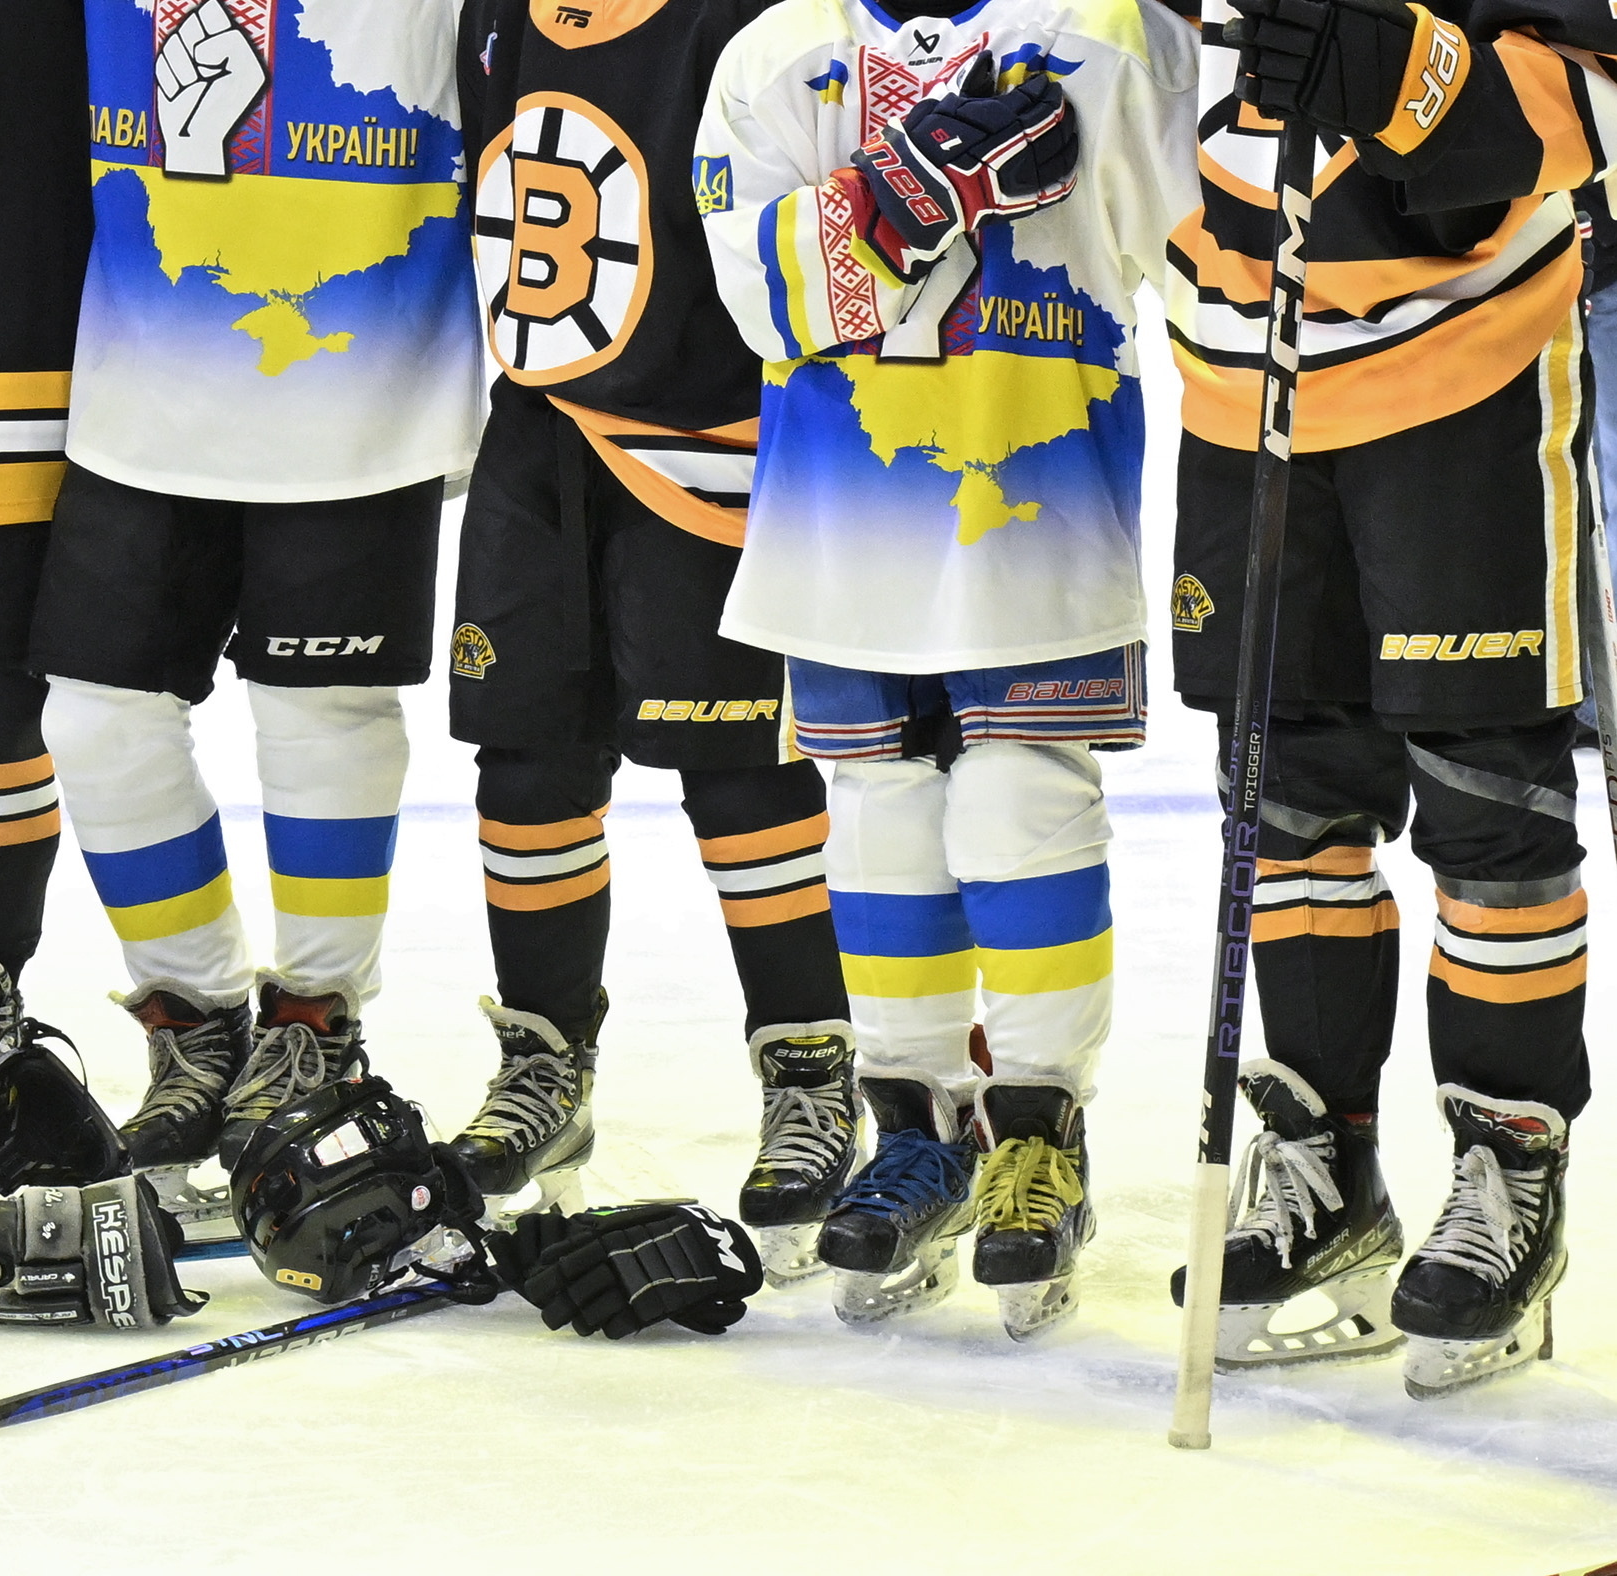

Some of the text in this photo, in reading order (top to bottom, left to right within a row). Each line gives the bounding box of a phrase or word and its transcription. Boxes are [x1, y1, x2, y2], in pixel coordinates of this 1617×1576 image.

[555, 5, 593, 30] TPS
[908, 55, 943, 66] BAUER
[288, 116, 418, 167] УКРАЇНІ!
[507, 157, 596, 320] B
[1264, 180, 1315, 462] CCM
[267, 635, 385, 657] CCM
[1380, 629, 1544, 661] BAUER
[1006, 678, 1124, 702] BAUER
[637, 699, 778, 722] BAUER
[1250, 721, 1262, 731] 7
[1244, 732, 1262, 812] TRIGGER
[1218, 820, 1258, 1060] RIBCOR
[775, 1045, 839, 1060] BAUER
